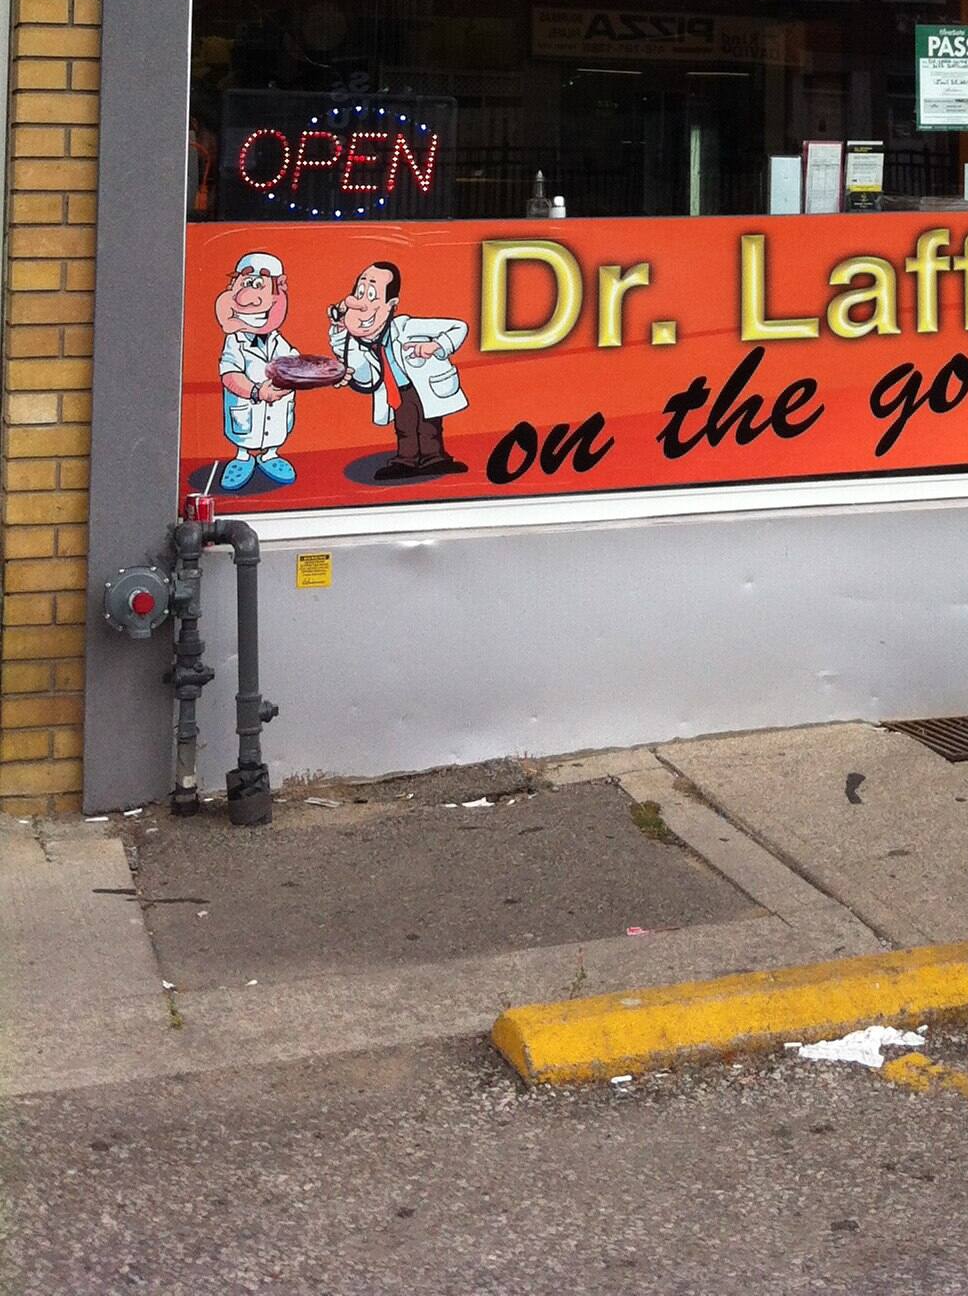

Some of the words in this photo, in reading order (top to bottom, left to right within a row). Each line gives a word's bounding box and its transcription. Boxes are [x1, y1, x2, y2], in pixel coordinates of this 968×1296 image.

[239, 127, 439, 192] OPEN
[480, 239, 677, 352] Dr.
[486, 409, 615, 484] on
[655, 346, 825, 459] the
